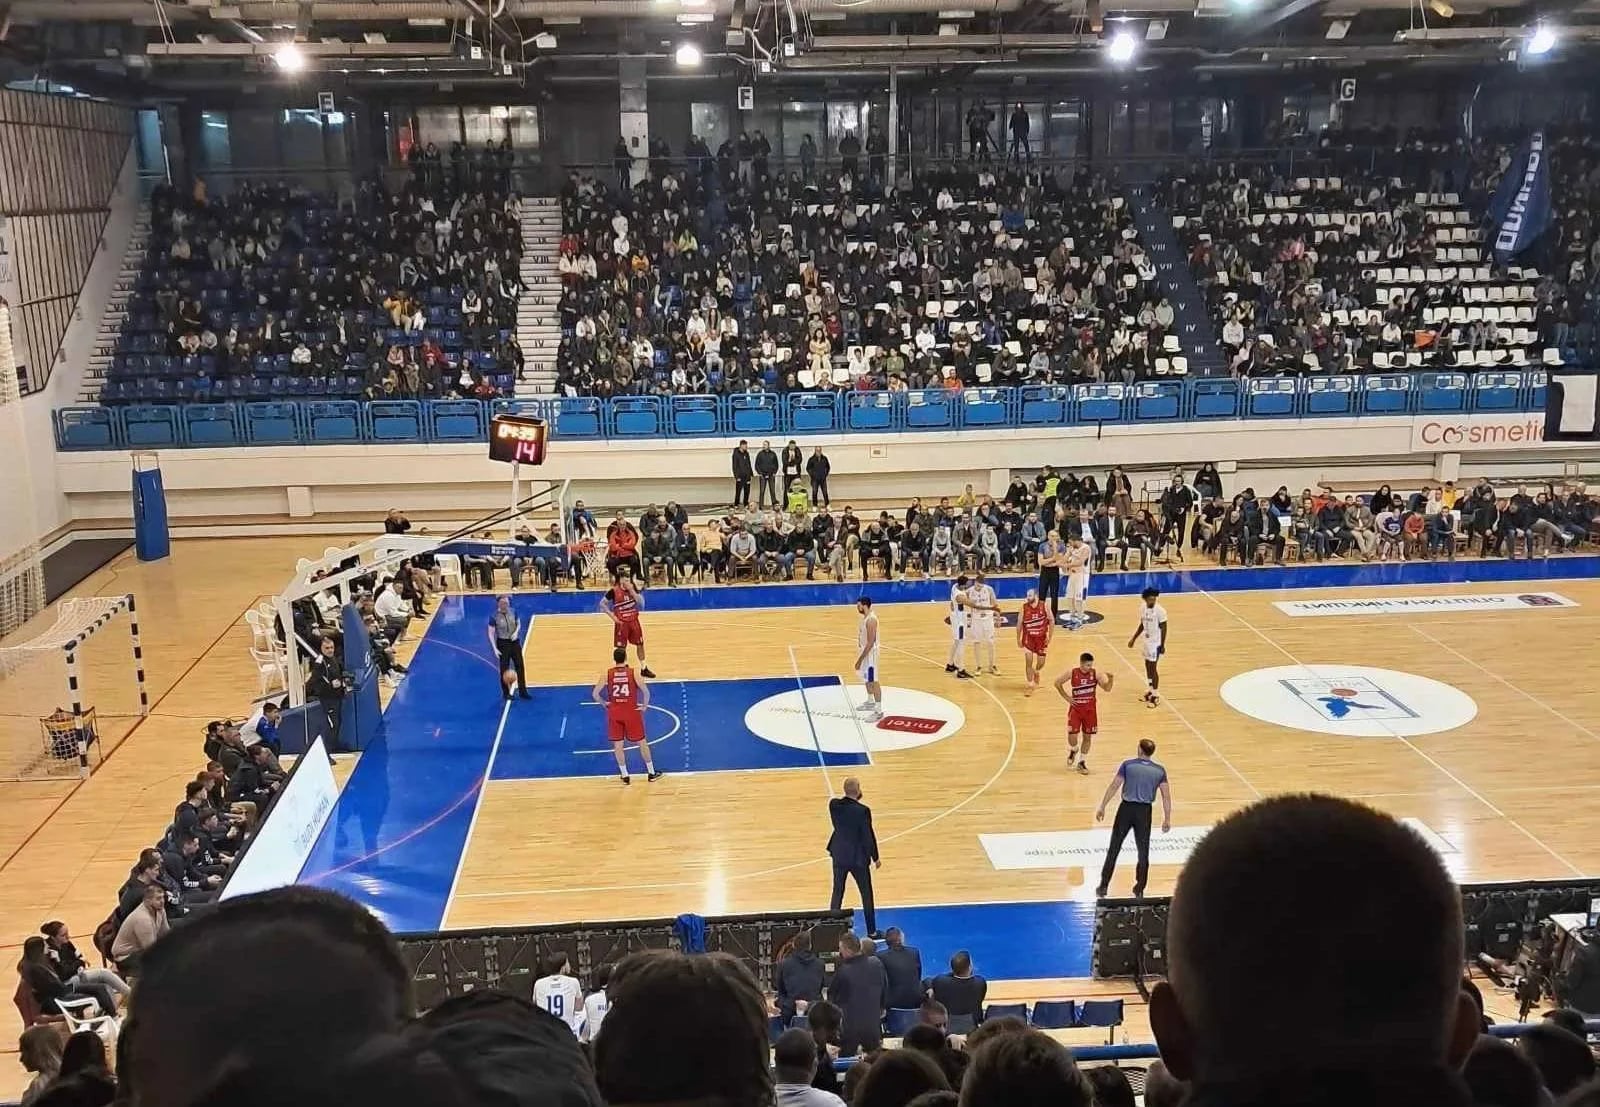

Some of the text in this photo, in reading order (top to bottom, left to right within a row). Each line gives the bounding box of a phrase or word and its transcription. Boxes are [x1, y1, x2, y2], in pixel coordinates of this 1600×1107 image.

[740, 89, 751, 107] F
[1342, 81, 1354, 99] G
[516, 441, 536, 461] 14
[612, 683, 630, 697] 24
[546, 994, 564, 1018] 19
